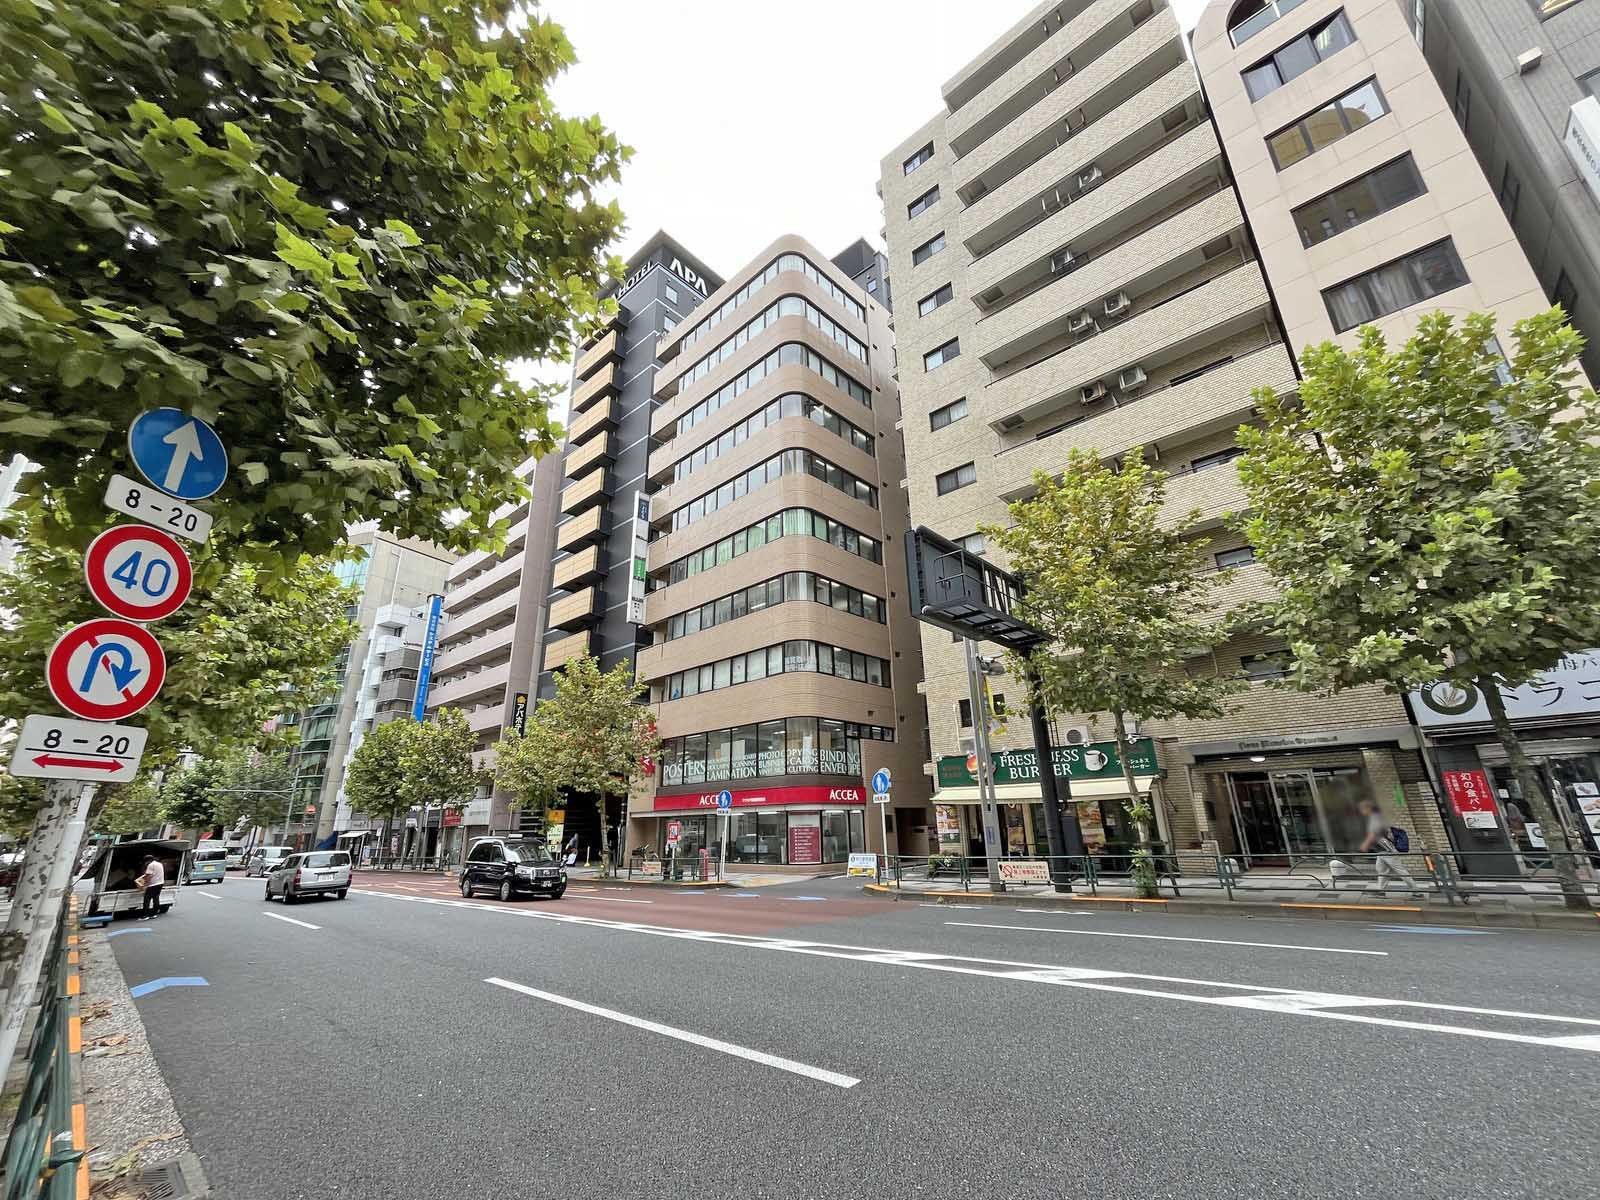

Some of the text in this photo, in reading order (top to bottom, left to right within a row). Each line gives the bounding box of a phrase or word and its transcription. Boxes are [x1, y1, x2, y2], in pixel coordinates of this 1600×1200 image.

[618, 261, 654, 297] HOTEL
[670, 258, 708, 296] APA
[112, 551, 171, 597] 40
[514, 703, 526, 736] アパホテ
[820, 749, 860, 764] BINDING
[663, 760, 705, 778] POSTERS
[707, 766, 756, 781] LAMINATION
[1010, 763, 1073, 779] BURER
[699, 795, 719, 806] ACCE
[829, 789, 859, 801] ACCEA
